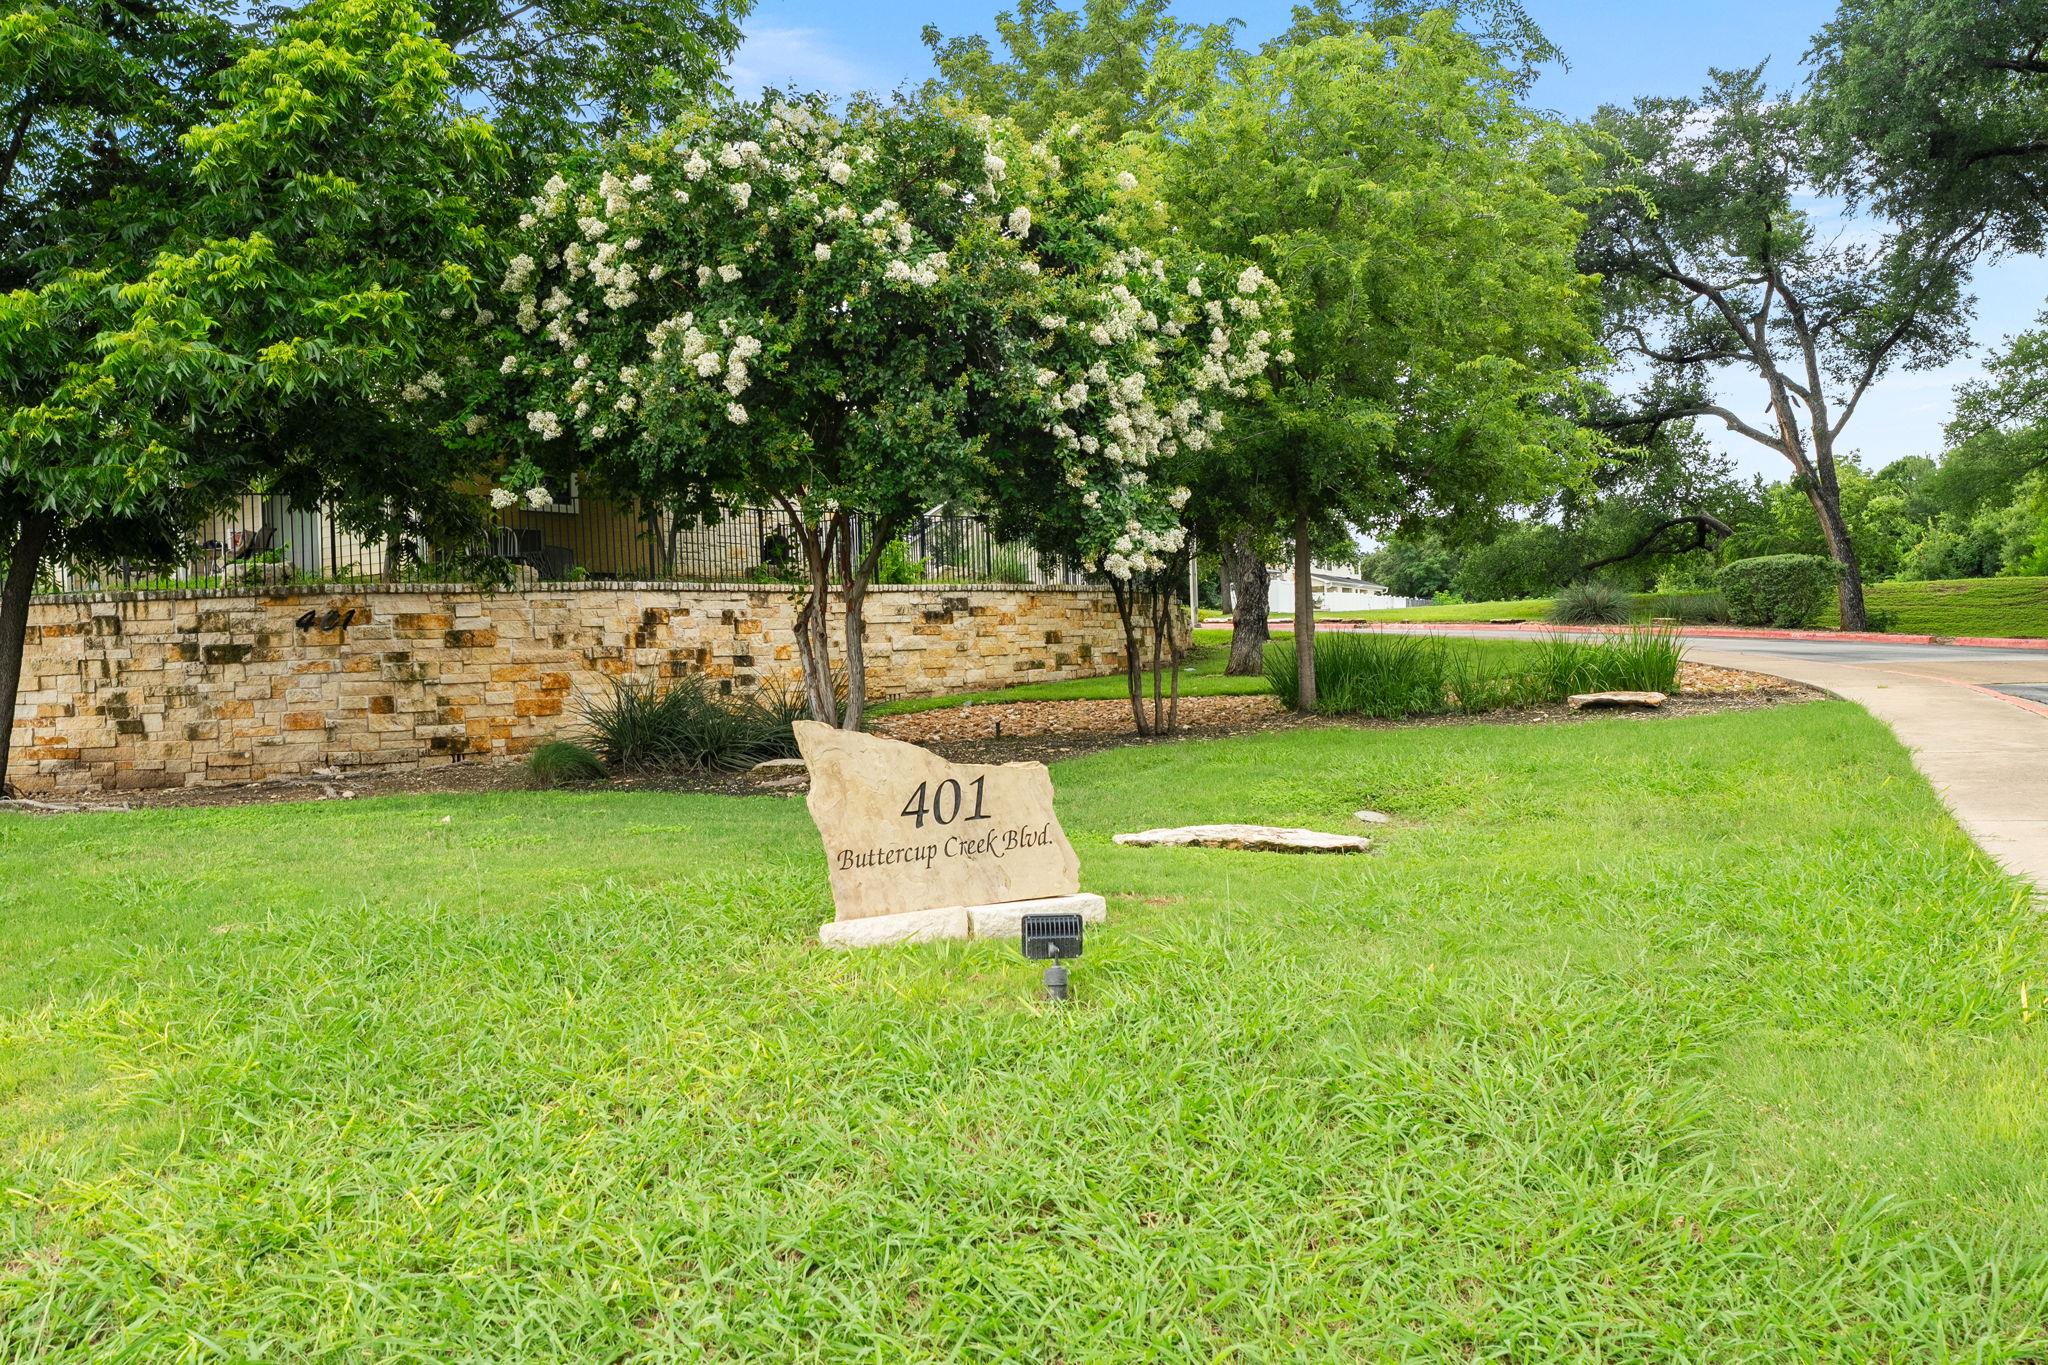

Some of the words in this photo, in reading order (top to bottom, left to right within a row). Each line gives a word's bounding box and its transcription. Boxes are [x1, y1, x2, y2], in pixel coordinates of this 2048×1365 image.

[295, 609, 356, 633] 401
[900, 775, 992, 829] 401
[837, 843, 938, 870] Buttercup
[944, 828, 1005, 858] Creek
[1002, 823, 1053, 850] Blvd.
